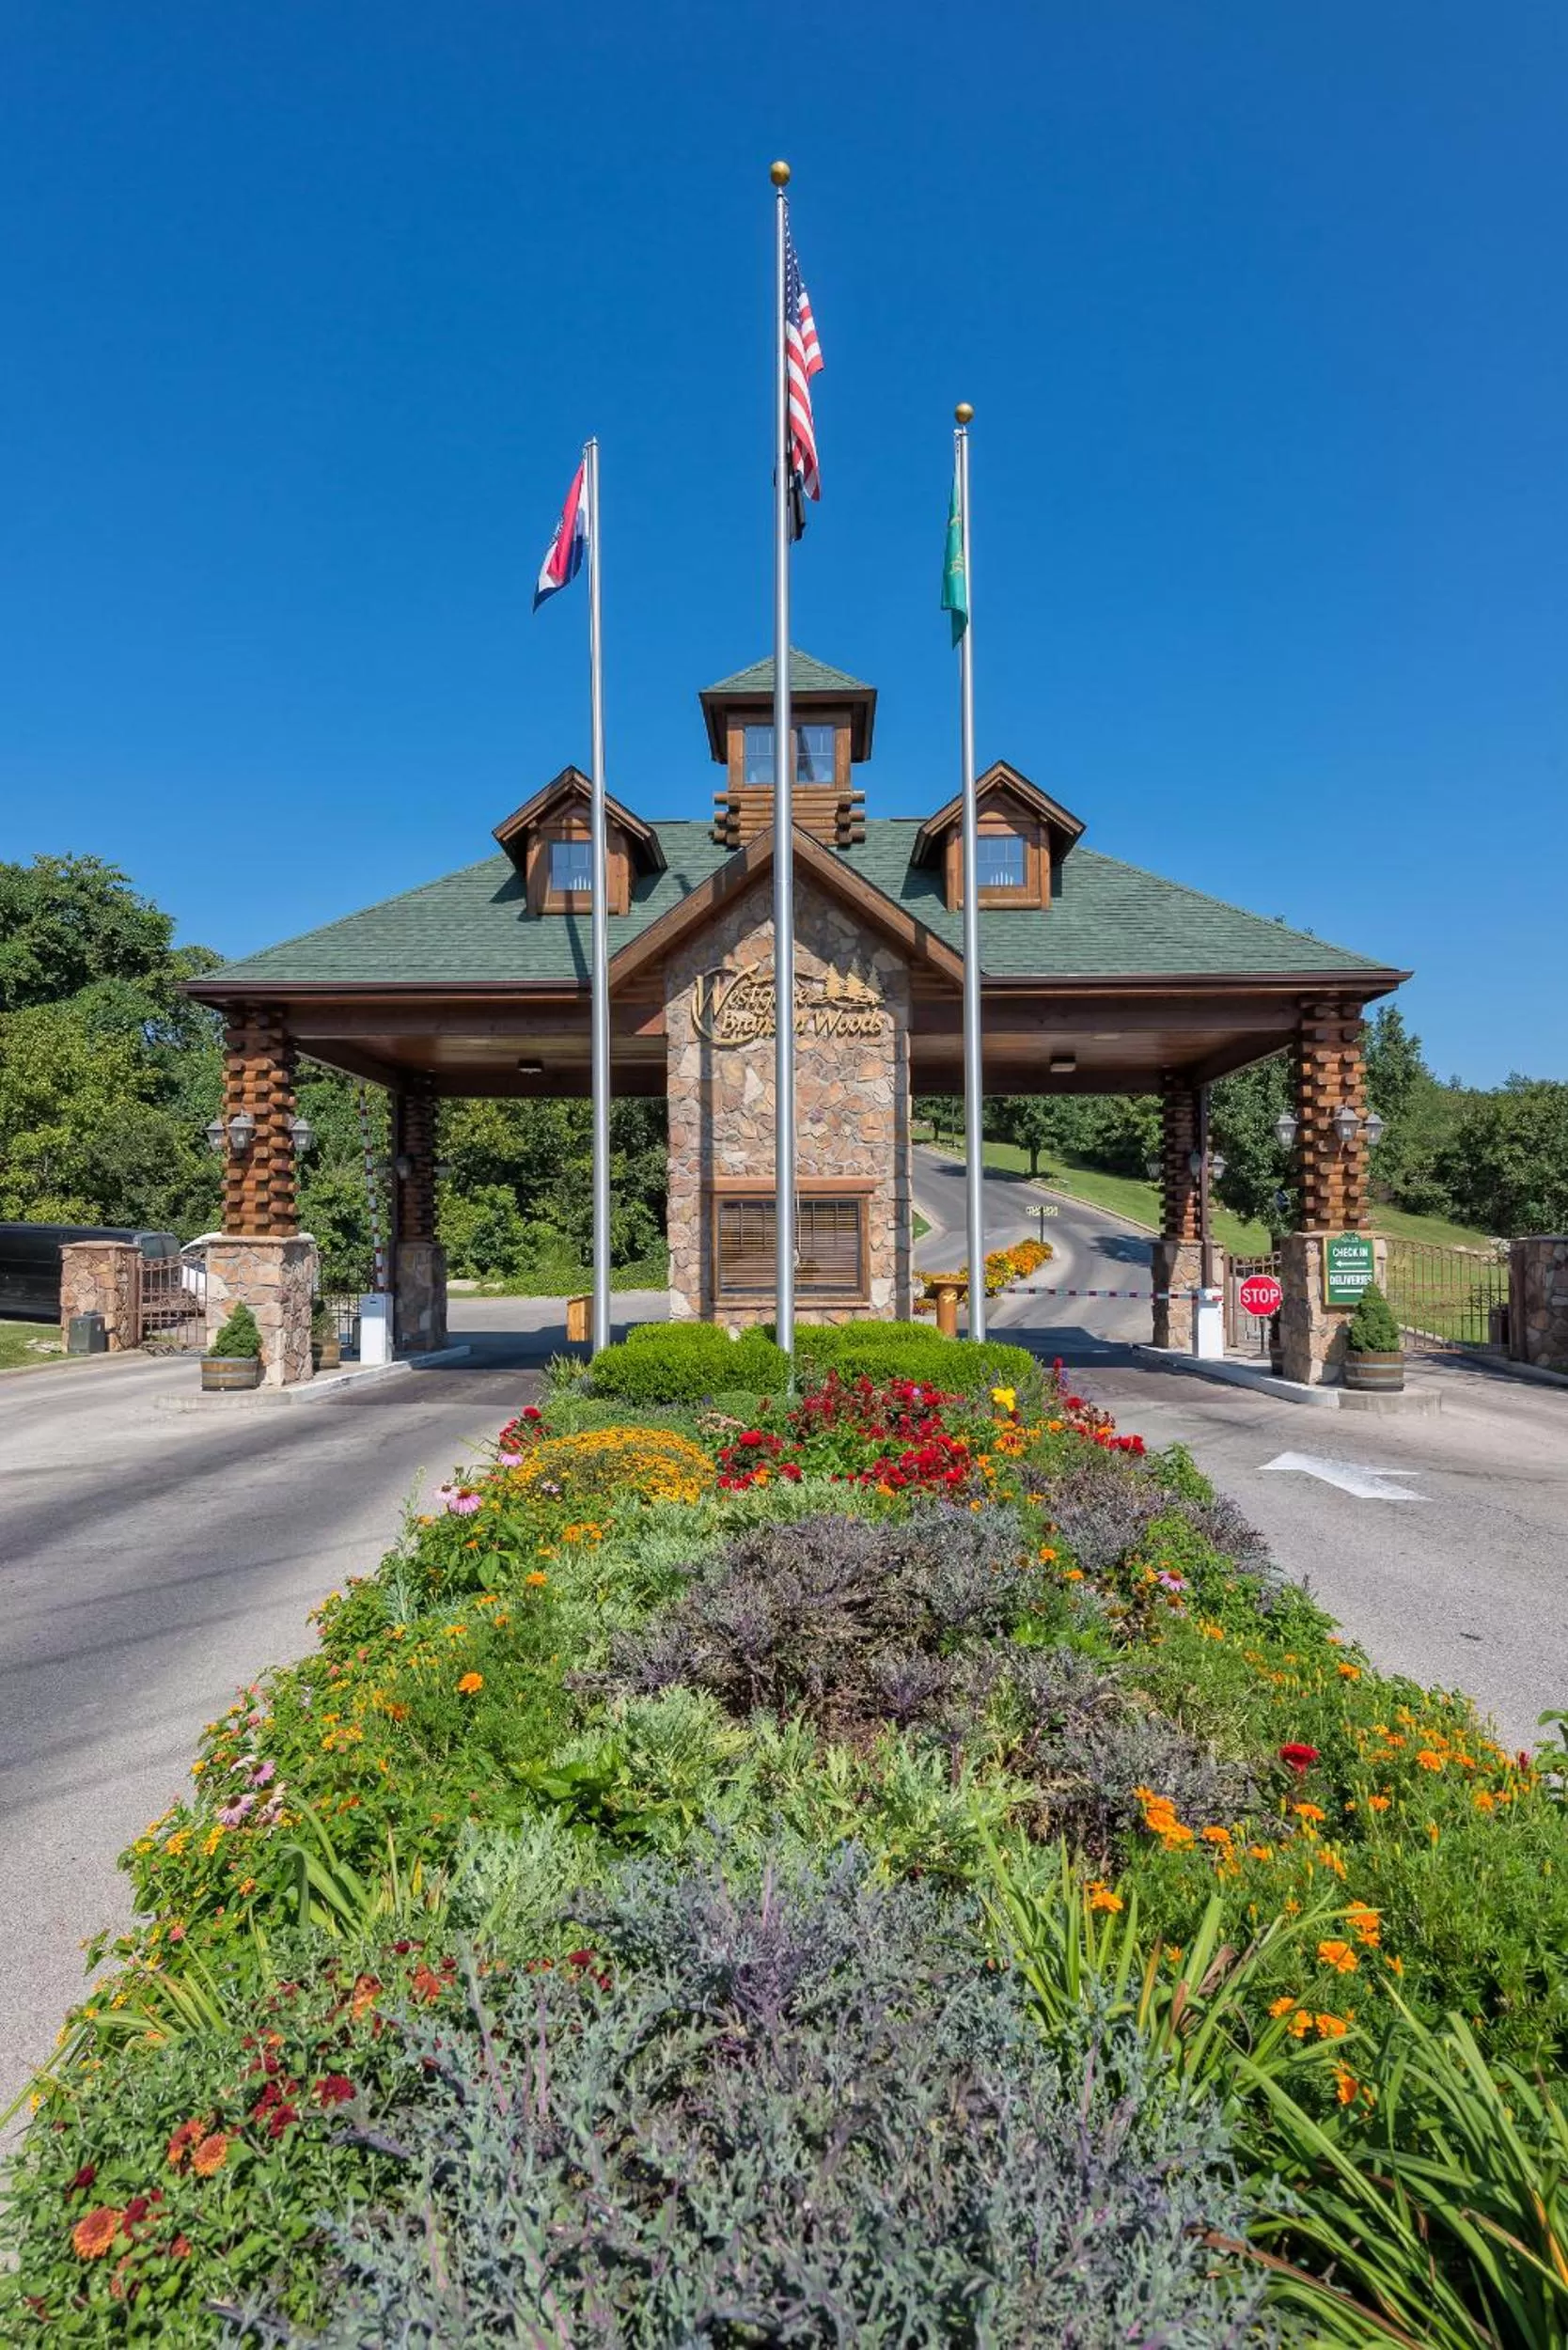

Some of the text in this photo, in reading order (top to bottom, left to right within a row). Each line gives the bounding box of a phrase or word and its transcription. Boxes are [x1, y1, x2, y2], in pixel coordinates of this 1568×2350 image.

[694, 963, 808, 1019] Westge
[722, 1008, 886, 1034] Bransn Woods
[1332, 1246, 1369, 1257] CHECK IN
[1242, 1288, 1279, 1304] STOP
